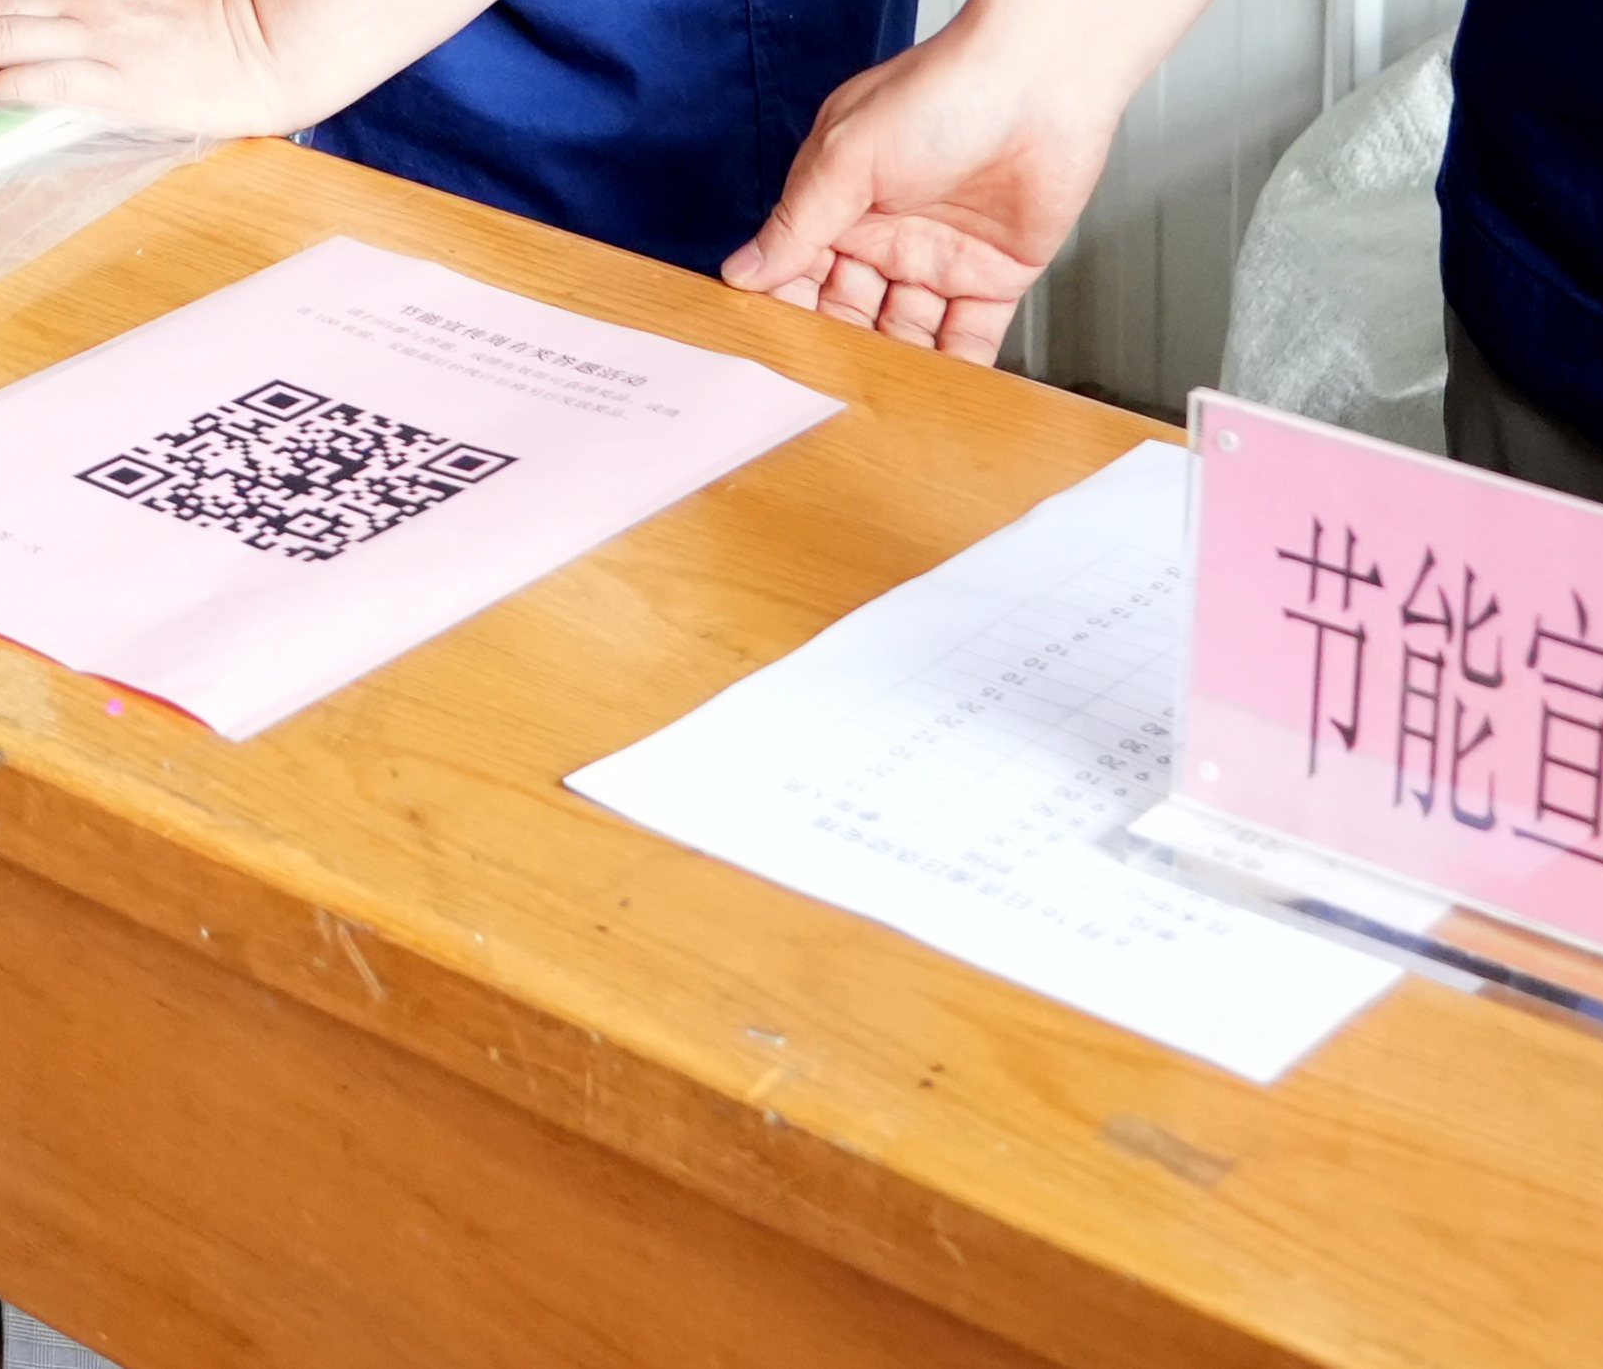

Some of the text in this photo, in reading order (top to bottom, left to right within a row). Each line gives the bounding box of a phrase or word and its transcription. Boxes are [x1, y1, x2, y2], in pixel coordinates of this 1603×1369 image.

[393, 303, 652, 387] 节能宣传周有奖答题活动
[1043, 643, 1070, 656] 10
[1022, 656, 1049, 670] 10
[999, 671, 1027, 685] 10
